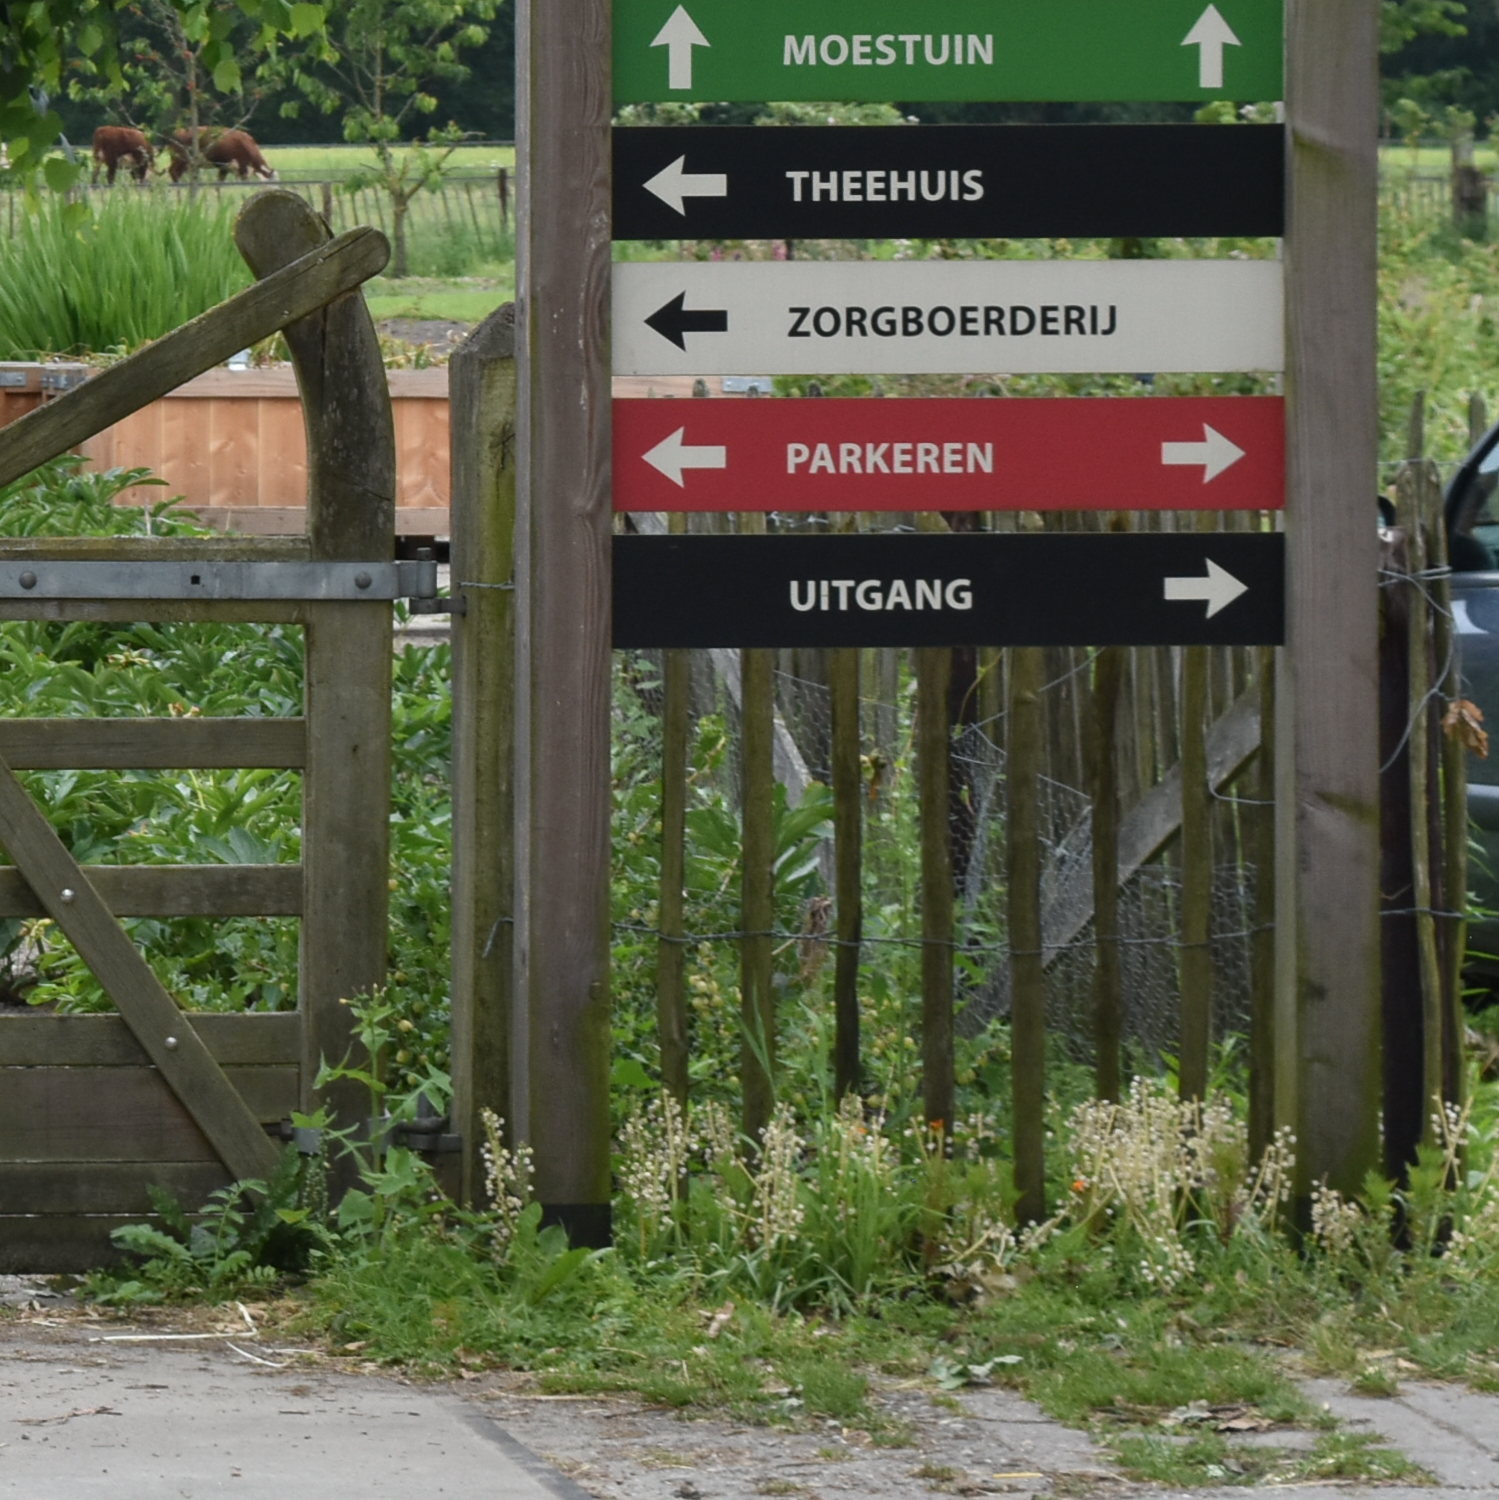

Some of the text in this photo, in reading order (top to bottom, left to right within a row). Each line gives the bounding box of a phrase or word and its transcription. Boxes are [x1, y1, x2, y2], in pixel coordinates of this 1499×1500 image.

[783, 33, 994, 67] MOESTUIN
[786, 170, 984, 202] THEEHUIS
[787, 305, 1117, 338] ZORGBOERDERIJ
[786, 443, 994, 475] PARKEREN
[789, 579, 973, 612] UITGANG
